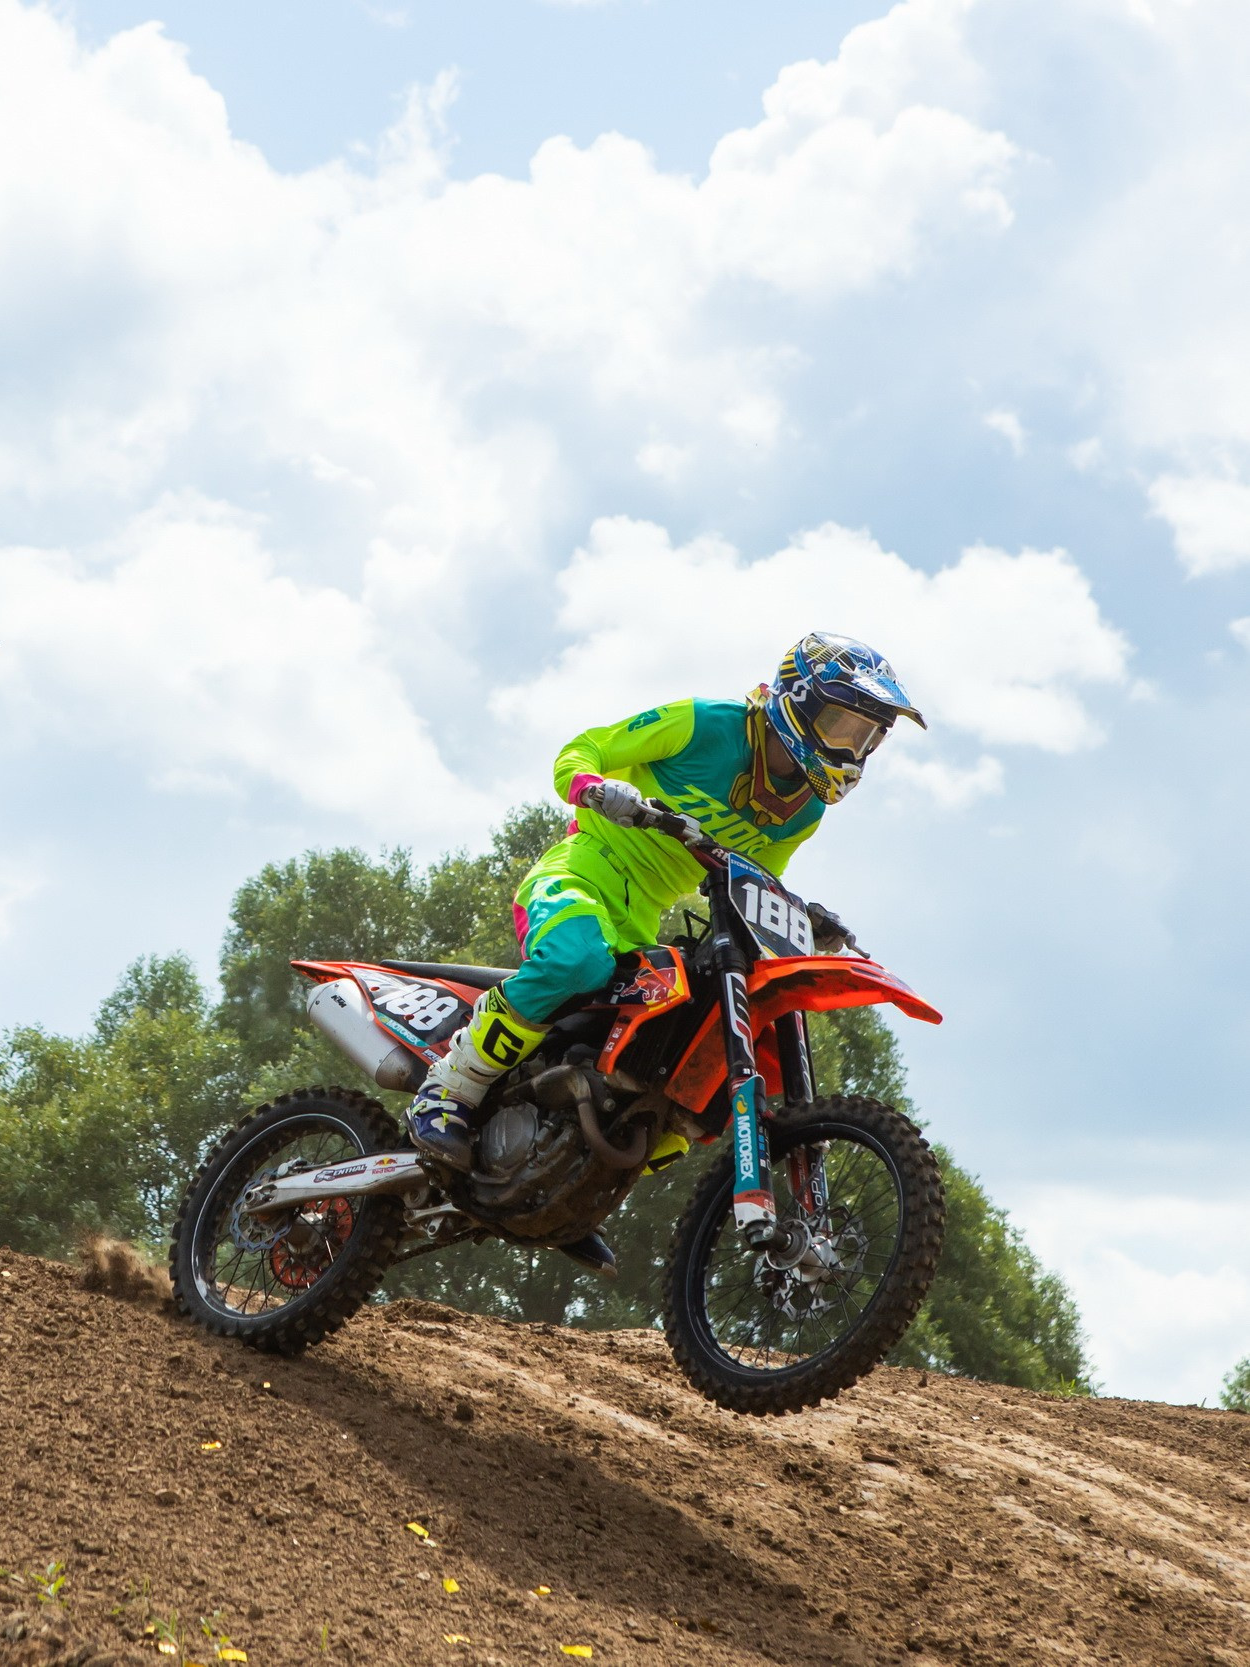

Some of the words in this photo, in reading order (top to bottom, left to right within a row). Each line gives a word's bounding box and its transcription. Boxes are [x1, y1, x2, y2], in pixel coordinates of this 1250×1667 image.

[742, 882, 811, 957] 188
[330, 994, 348, 1008] KTM
[372, 983, 459, 1031] 188
[386, 1019, 418, 1046] MOTOREX
[737, 1115, 755, 1182] MOTOREX
